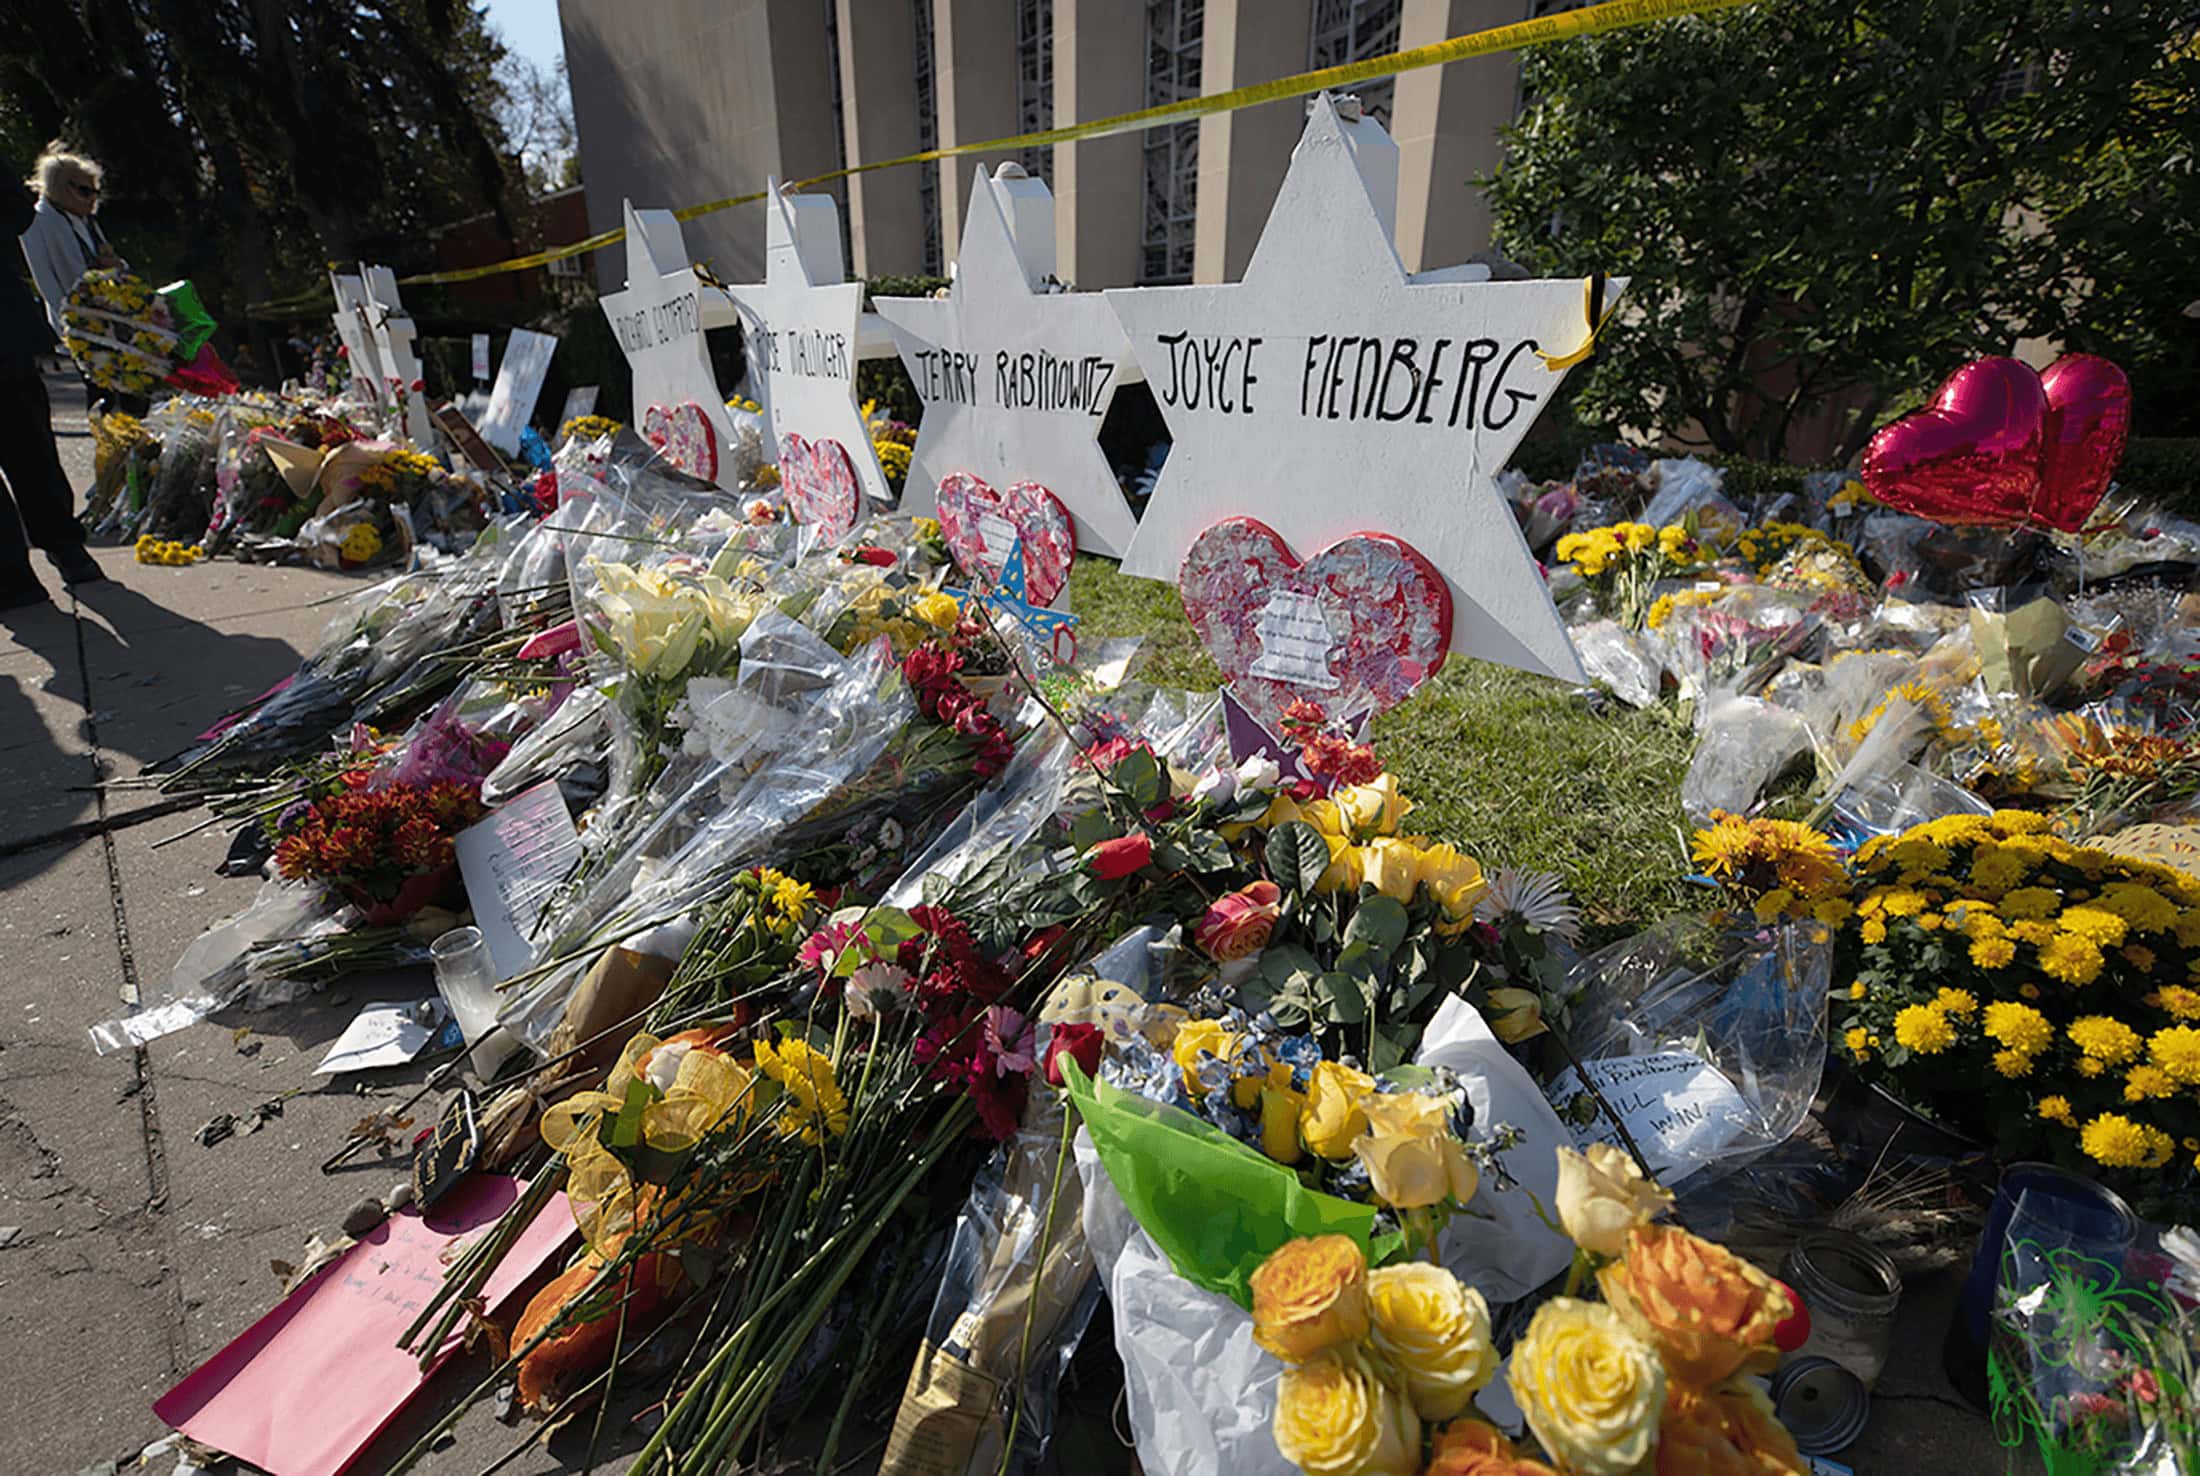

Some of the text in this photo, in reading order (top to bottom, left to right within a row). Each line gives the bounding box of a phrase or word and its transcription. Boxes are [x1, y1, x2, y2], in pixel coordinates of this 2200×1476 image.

[915, 348, 1115, 416] JERRY RABINOWITZ
[1158, 330, 1540, 431] JOYCE FIENBERG
